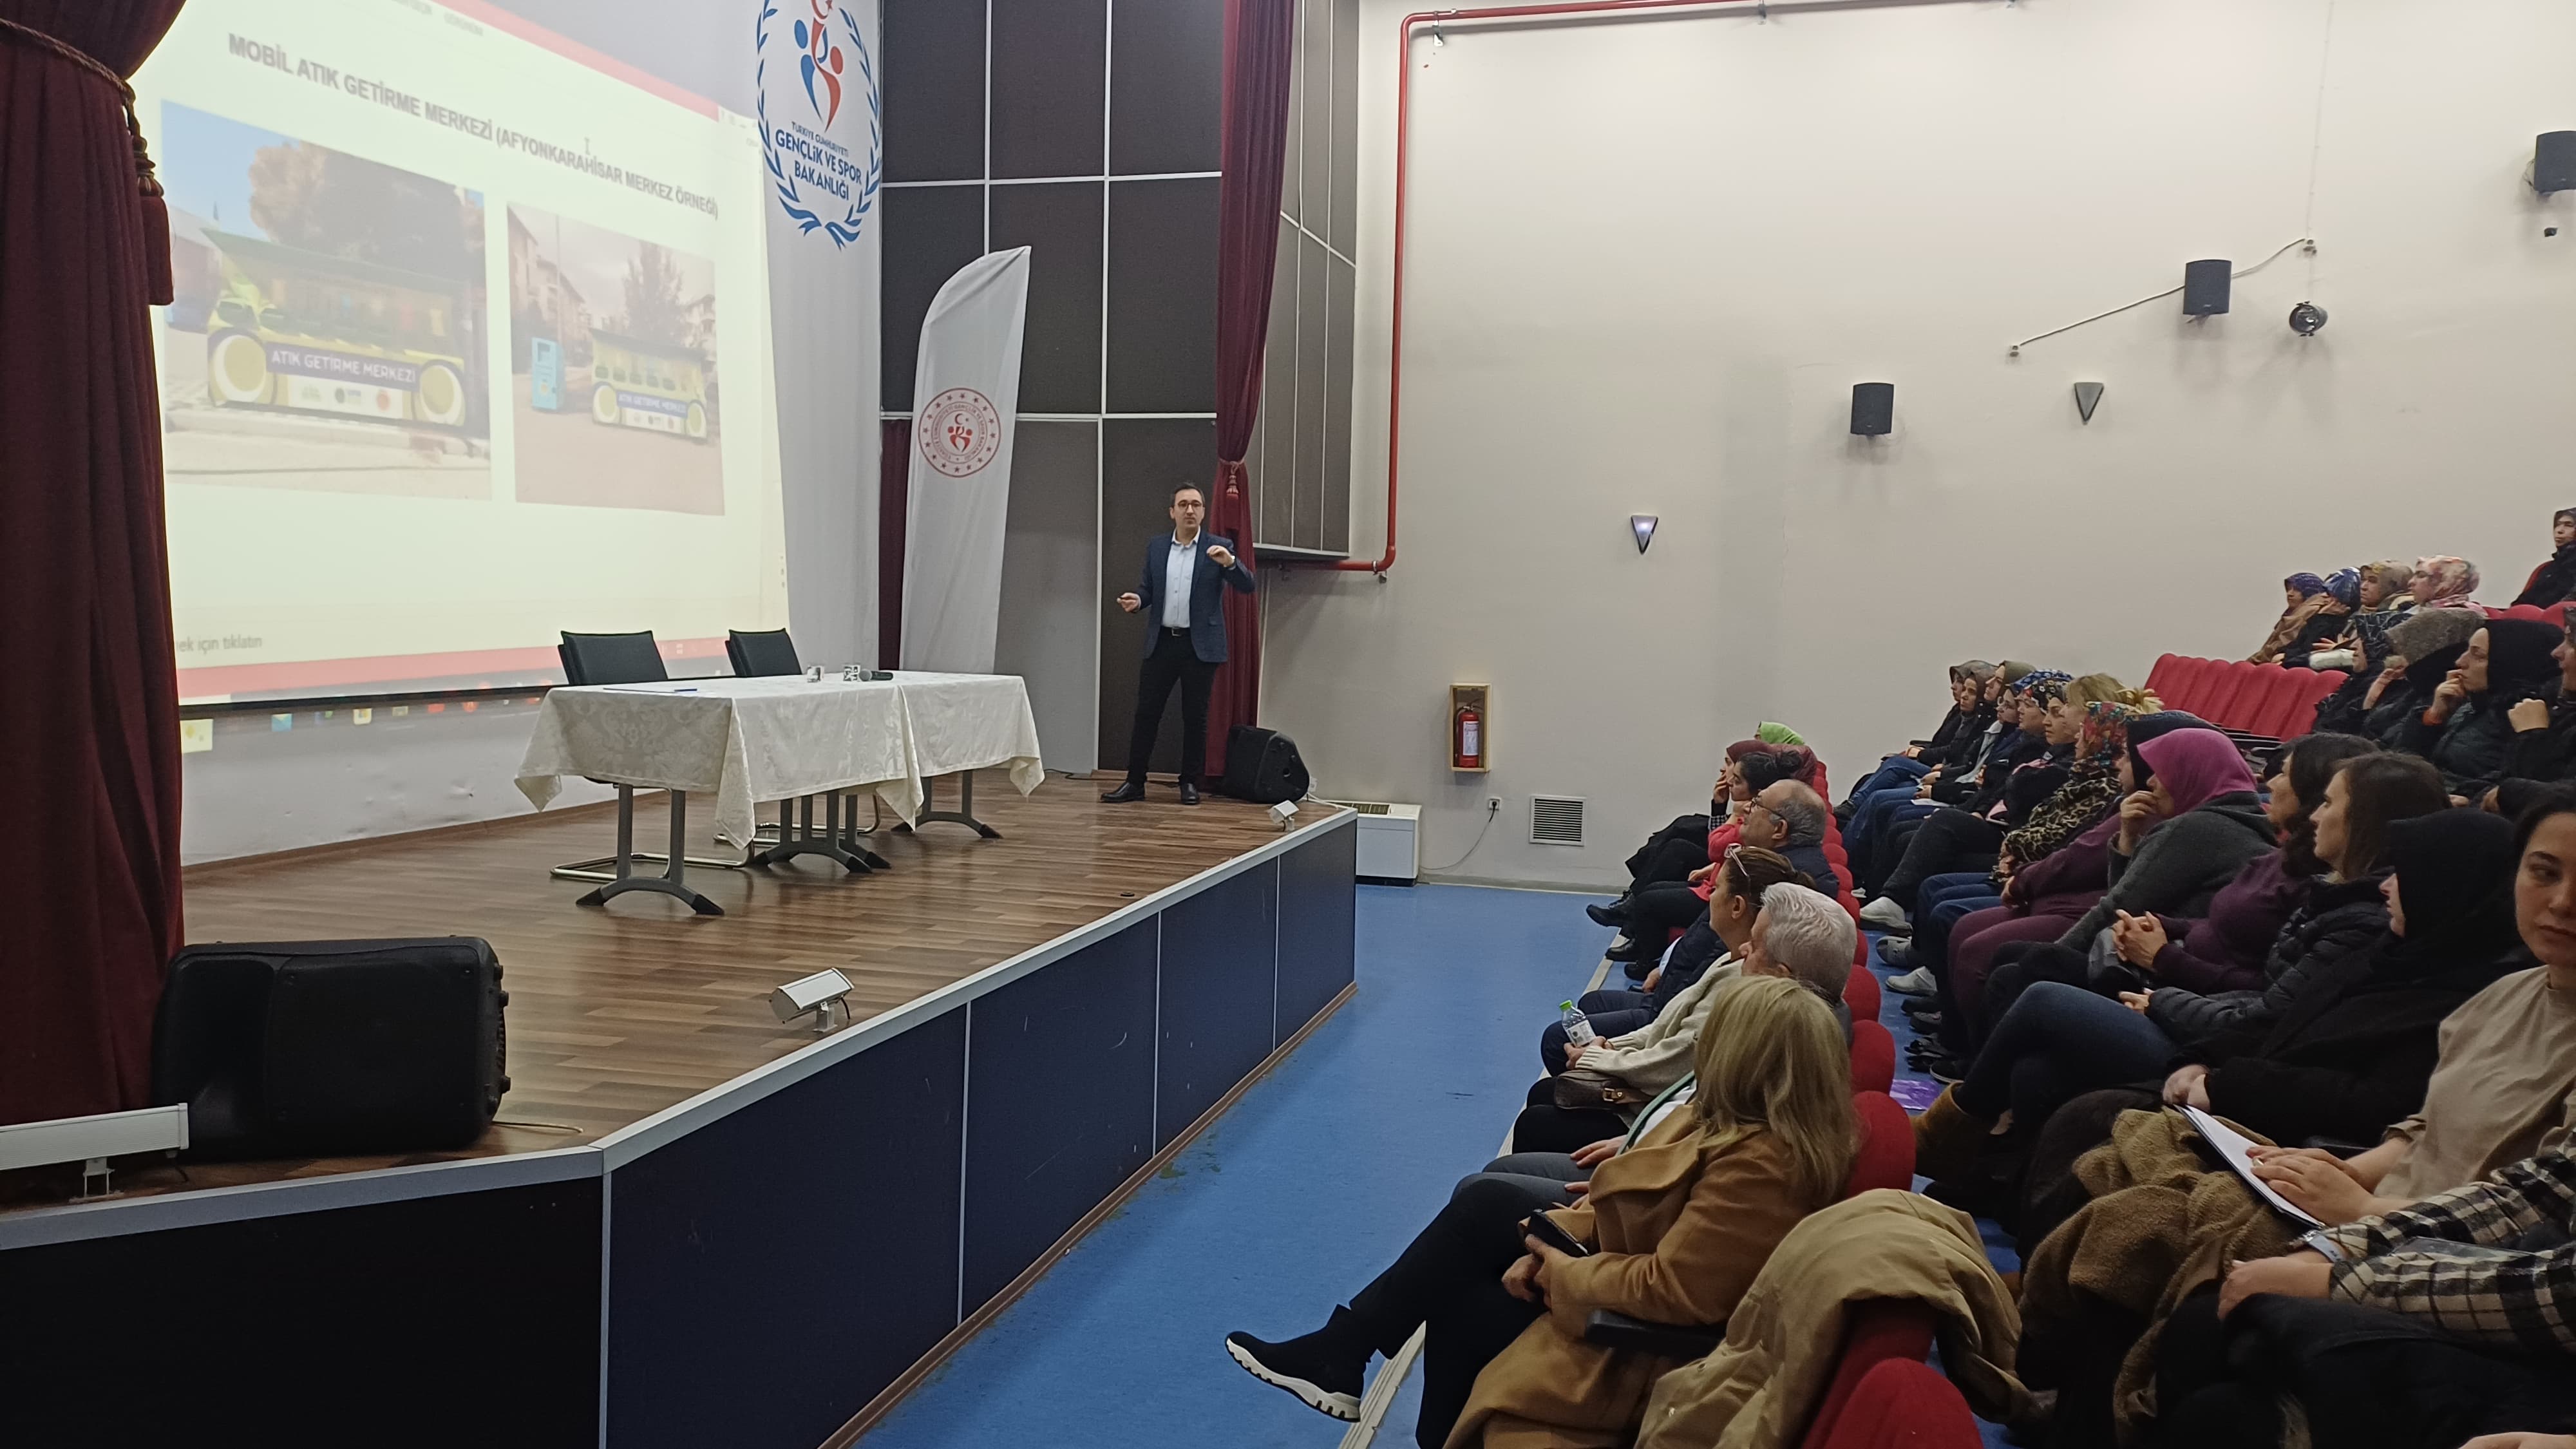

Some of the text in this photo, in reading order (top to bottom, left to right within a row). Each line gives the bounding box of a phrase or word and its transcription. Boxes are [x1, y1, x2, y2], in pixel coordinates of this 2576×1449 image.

[229, 32, 294, 74] MOBİL
[296, 58, 340, 90] ATIK
[344, 74, 421, 117] GETİRME
[425, 102, 493, 141] MERKEZİ
[625, 171, 674, 202] MERKEZ
[775, 129, 862, 185] GENÇLİK VE SPOR
[794, 160, 849, 201] BAKANLIĞI
[272, 350, 301, 366] ATIK
